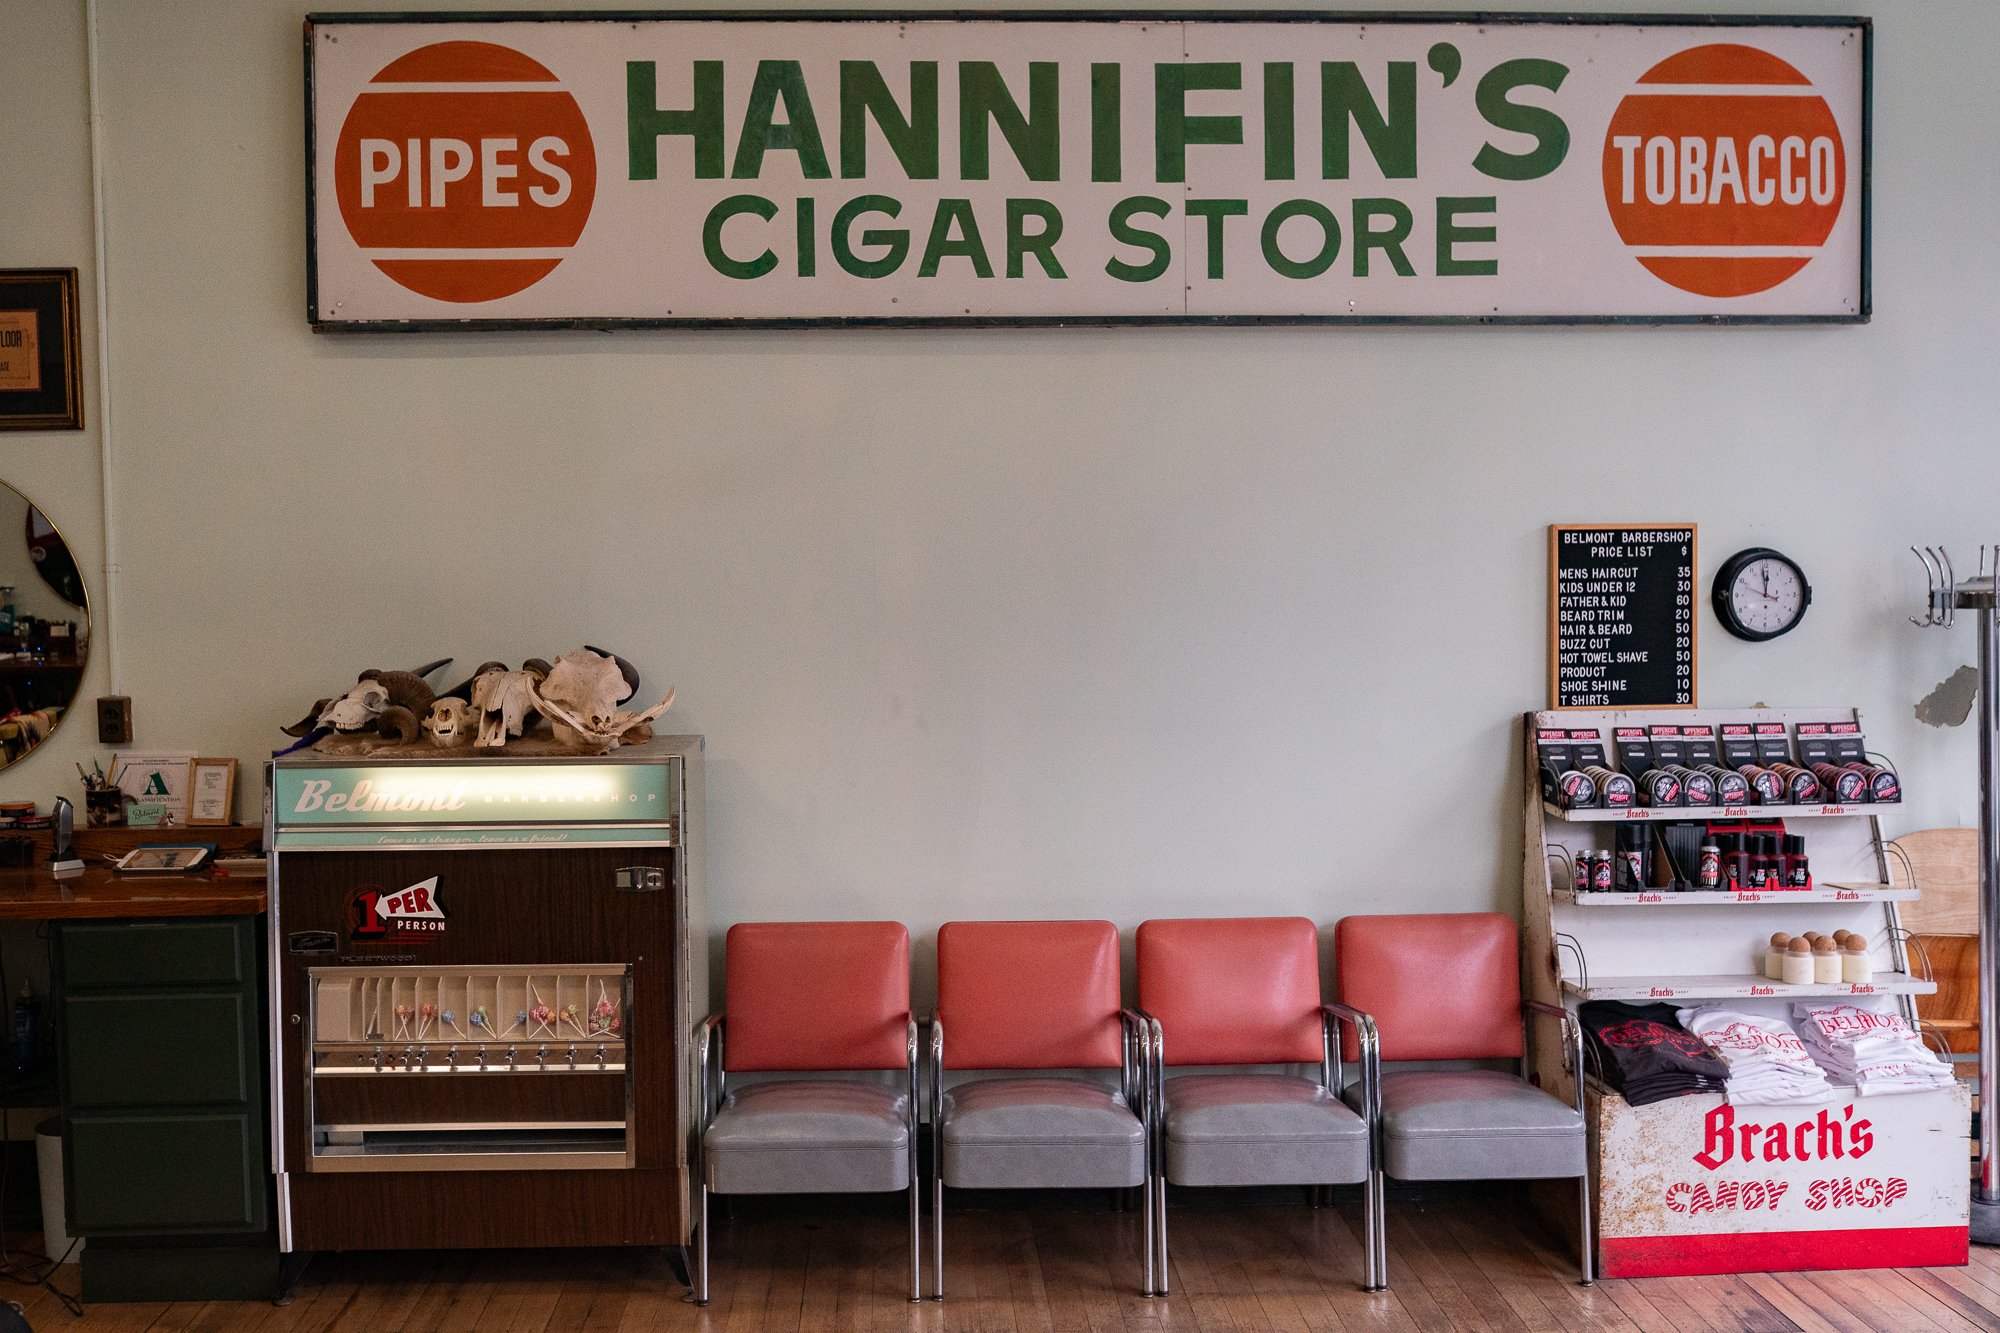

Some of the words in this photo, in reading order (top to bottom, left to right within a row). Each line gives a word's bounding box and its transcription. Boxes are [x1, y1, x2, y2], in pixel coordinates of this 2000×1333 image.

[626, 42, 1571, 183] HANNIFIN'S
[360, 136, 572, 208] PIPES
[1613, 134, 1836, 206] TOBACCO
[702, 194, 1069, 279] CIGAR
[1105, 195, 1498, 283] STORE
[0, 330, 22, 348] LOOR
[1564, 532, 1615, 544] BELMONT
[1621, 531, 1692, 543] BARBERSHOP
[1591, 546, 1623, 558] PRICE
[1627, 546, 1654, 557] LIST
[1681, 545, 1687, 556] $
[1559, 568, 1589, 579] MENS
[1592, 567, 1639, 579] HAIRCUT
[1677, 566, 1691, 578] 35
[1559, 582, 1584, 593] KIDS
[1586, 582, 1623, 593] UNDER
[1626, 581, 1636, 592] 12
[1677, 581, 1691, 592] 30
[1560, 596, 1600, 607] FATHER
[1601, 596, 1609, 607] &
[1610, 595, 1627, 607] KID
[1676, 595, 1690, 606] 60
[1560, 610, 1595, 621] BEARD
[1598, 610, 1625, 621] TRIM
[1675, 609, 1690, 620] 20
[1560, 624, 1586, 635] HAIR
[1588, 624, 1596, 635] &
[1598, 623, 1633, 635] BEARD
[1675, 622, 1690, 633] 50
[1560, 639, 1586, 650] BUZZ
[1589, 638, 1611, 649] CUT
[1676, 636, 1690, 647] 20
[1560, 653, 1579, 664] HOT
[1581, 652, 1614, 663] TOWEL
[1616, 651, 1649, 662] SHAVE
[1676, 650, 1690, 661] 50
[1560, 666, 1606, 678] PRODUCT
[1676, 664, 1690, 675] 20
[1561, 681, 1588, 692] SHOE
[1591, 680, 1627, 692] SHINE
[1677, 679, 1690, 690] 10
[1560, 695, 1567, 706] T
[1571, 694, 1610, 706] SHIRTS
[1676, 692, 1690, 703] 30
[1683, 727, 1710, 735] UPPERCUT
[1723, 725, 1749, 733] UPPERCUT
[1757, 725, 1783, 733] UPPERCUT
[1799, 725, 1826, 733] UPPERCUT
[1830, 724, 1857, 732] UPPERCUT
[143, 771, 171, 796] A
[294, 779, 469, 813] Belmont
[1626, 809, 1650, 818] Brach's
[1724, 807, 1748, 816] Brach's
[1821, 806, 1845, 815] Brach's
[1638, 893, 1662, 902] Brach's
[1737, 892, 1760, 902] Brach's
[1836, 890, 1859, 900] Brach's
[358, 889, 386, 933] 1
[387, 888, 434, 914] PER
[397, 920, 446, 931] PERSON
[1650, 987, 1674, 997] Brach's
[1750, 985, 1774, 995] Brach's
[1850, 983, 1874, 993] Brach's
[1692, 1103, 1874, 1171] Brach's
[1665, 1180, 1789, 1215] CANDY
[1804, 1176, 1908, 1211] SHOP
